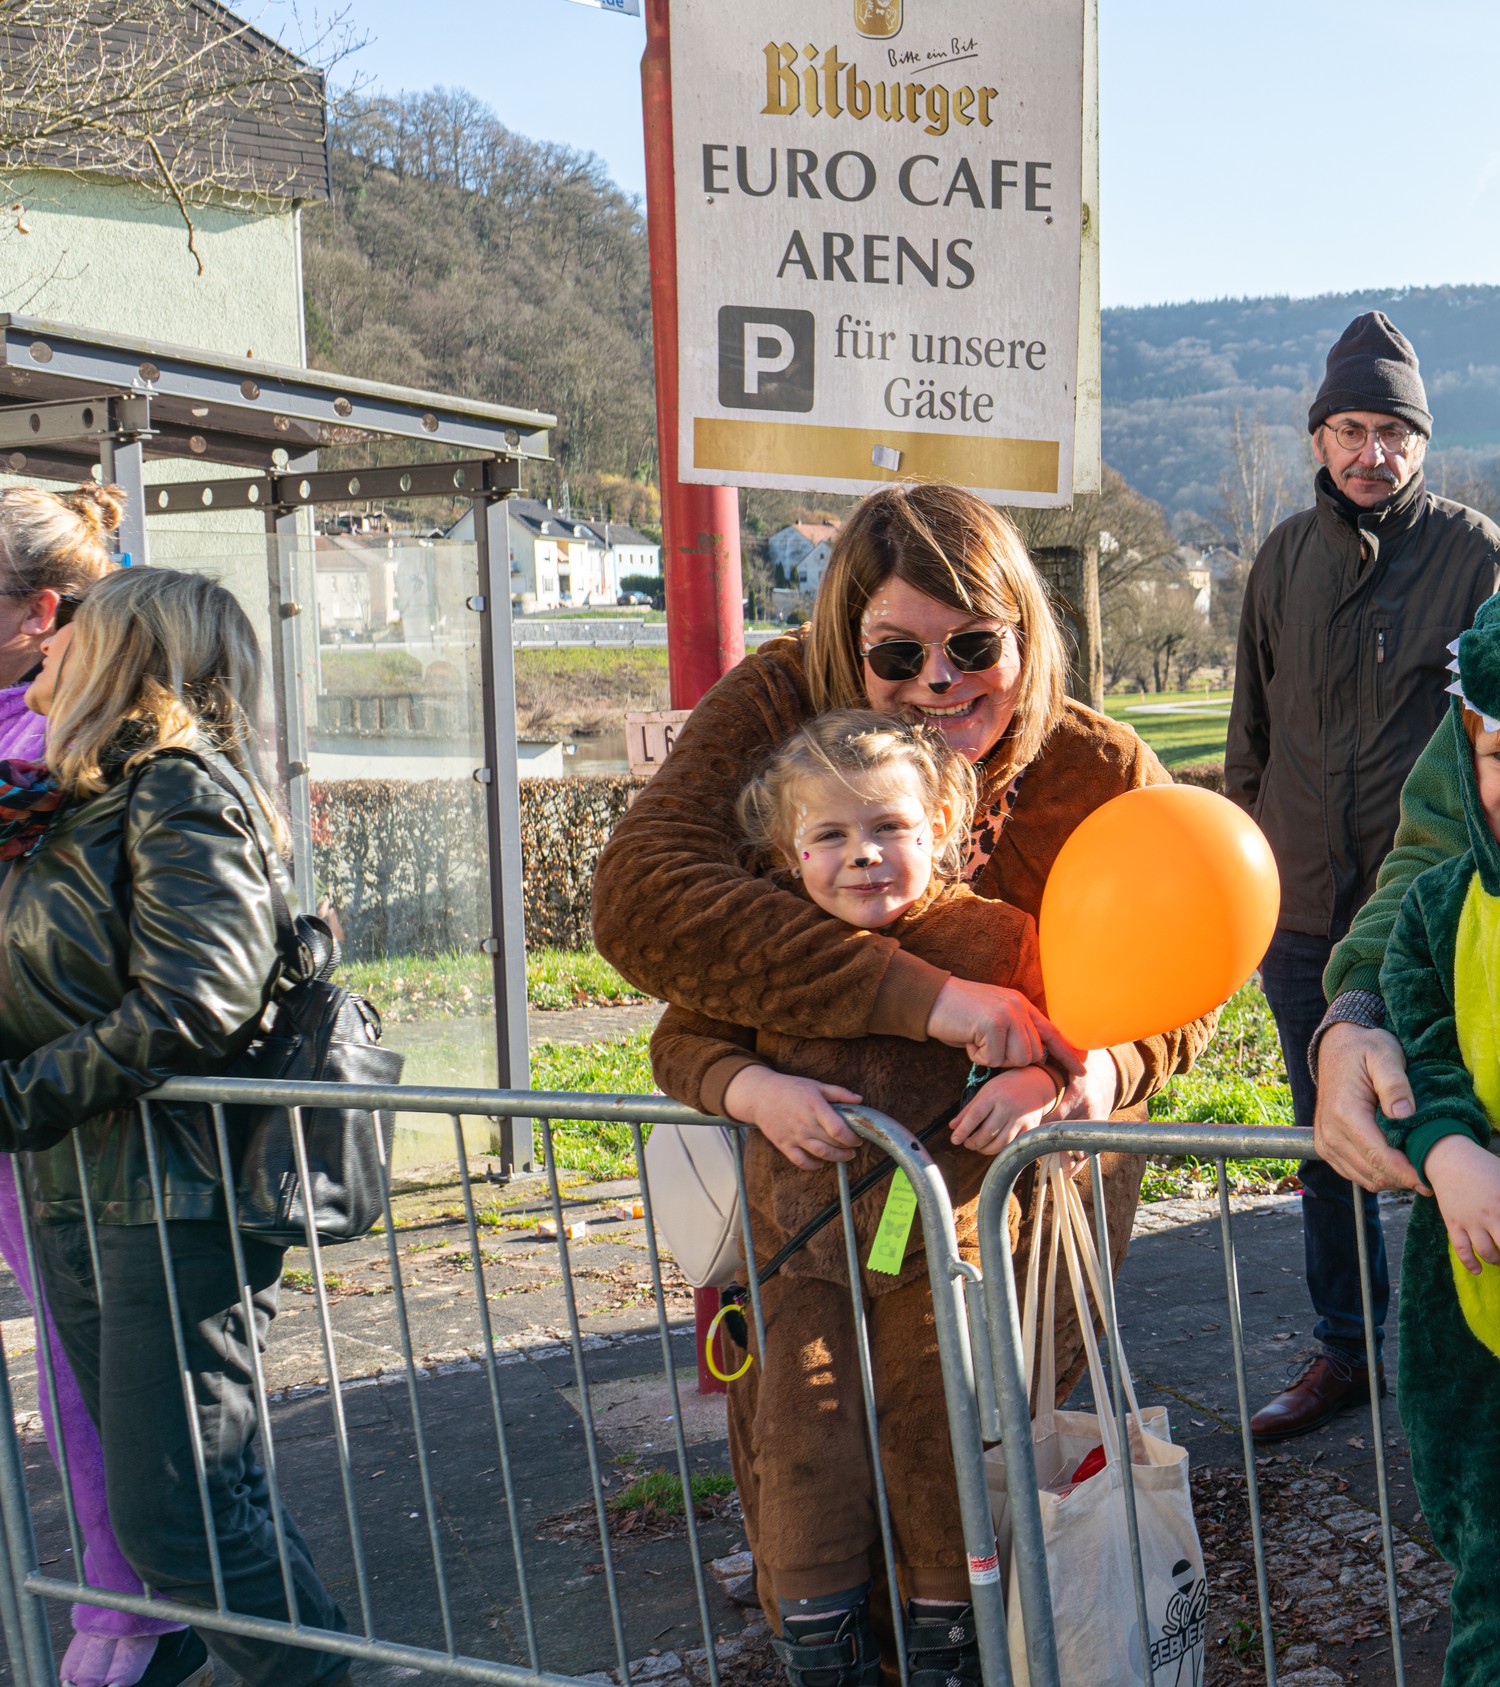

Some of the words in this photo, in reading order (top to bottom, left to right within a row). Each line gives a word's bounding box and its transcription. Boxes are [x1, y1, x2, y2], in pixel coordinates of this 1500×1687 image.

[887, 48, 921, 68] Bitte
[926, 49, 948, 60] ein
[951, 37, 979, 55] Bit
[759, 41, 999, 137] Bitburger
[702, 143, 877, 202] EURO
[898, 154, 1053, 213] CAFE
[776, 229, 976, 289] ARENS
[743, 322, 795, 395] P
[834, 314, 896, 361] für
[909, 332, 1047, 371] unsere
[883, 377, 994, 424] Gäste
[641, 725, 654, 762] L
